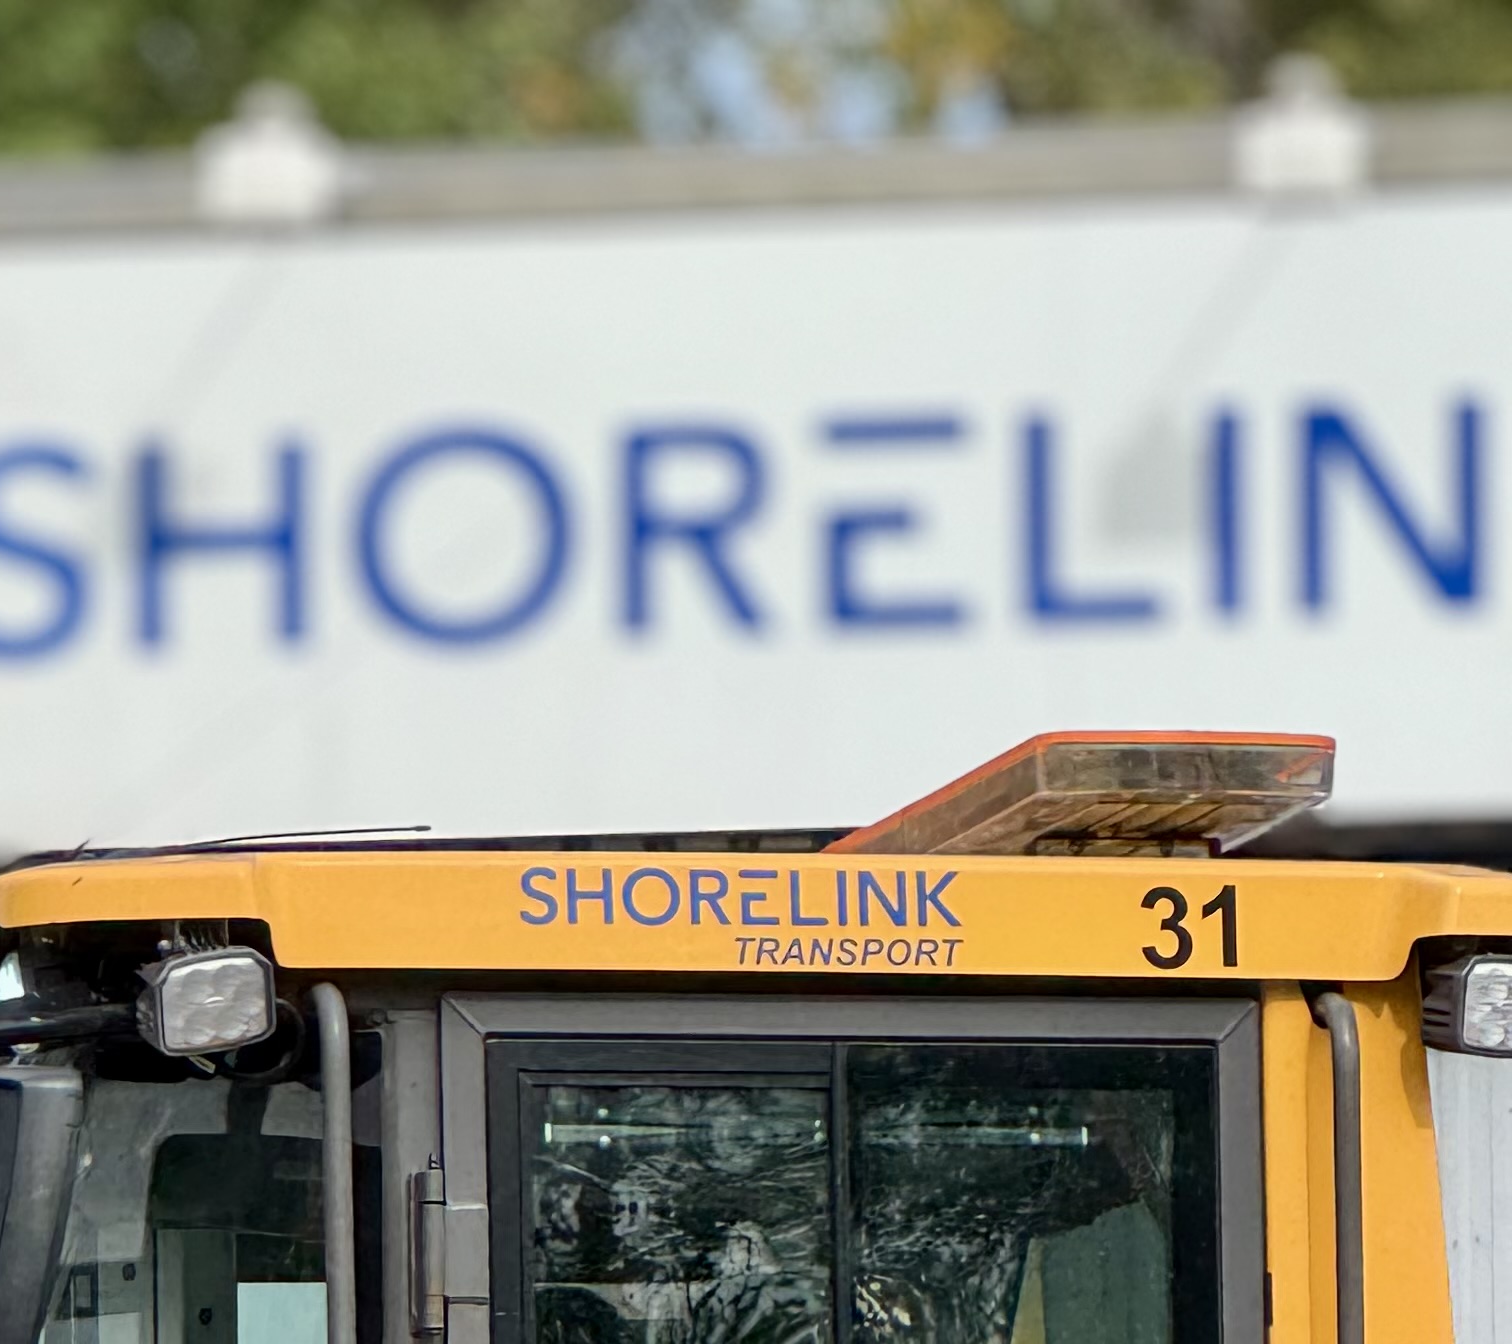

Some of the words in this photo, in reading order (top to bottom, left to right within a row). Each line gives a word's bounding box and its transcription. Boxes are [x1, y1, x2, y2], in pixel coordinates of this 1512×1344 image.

[519, 866, 964, 927] SHORELINK
[1139, 884, 1238, 970] 31
[735, 937, 965, 968] TRANSPORT
